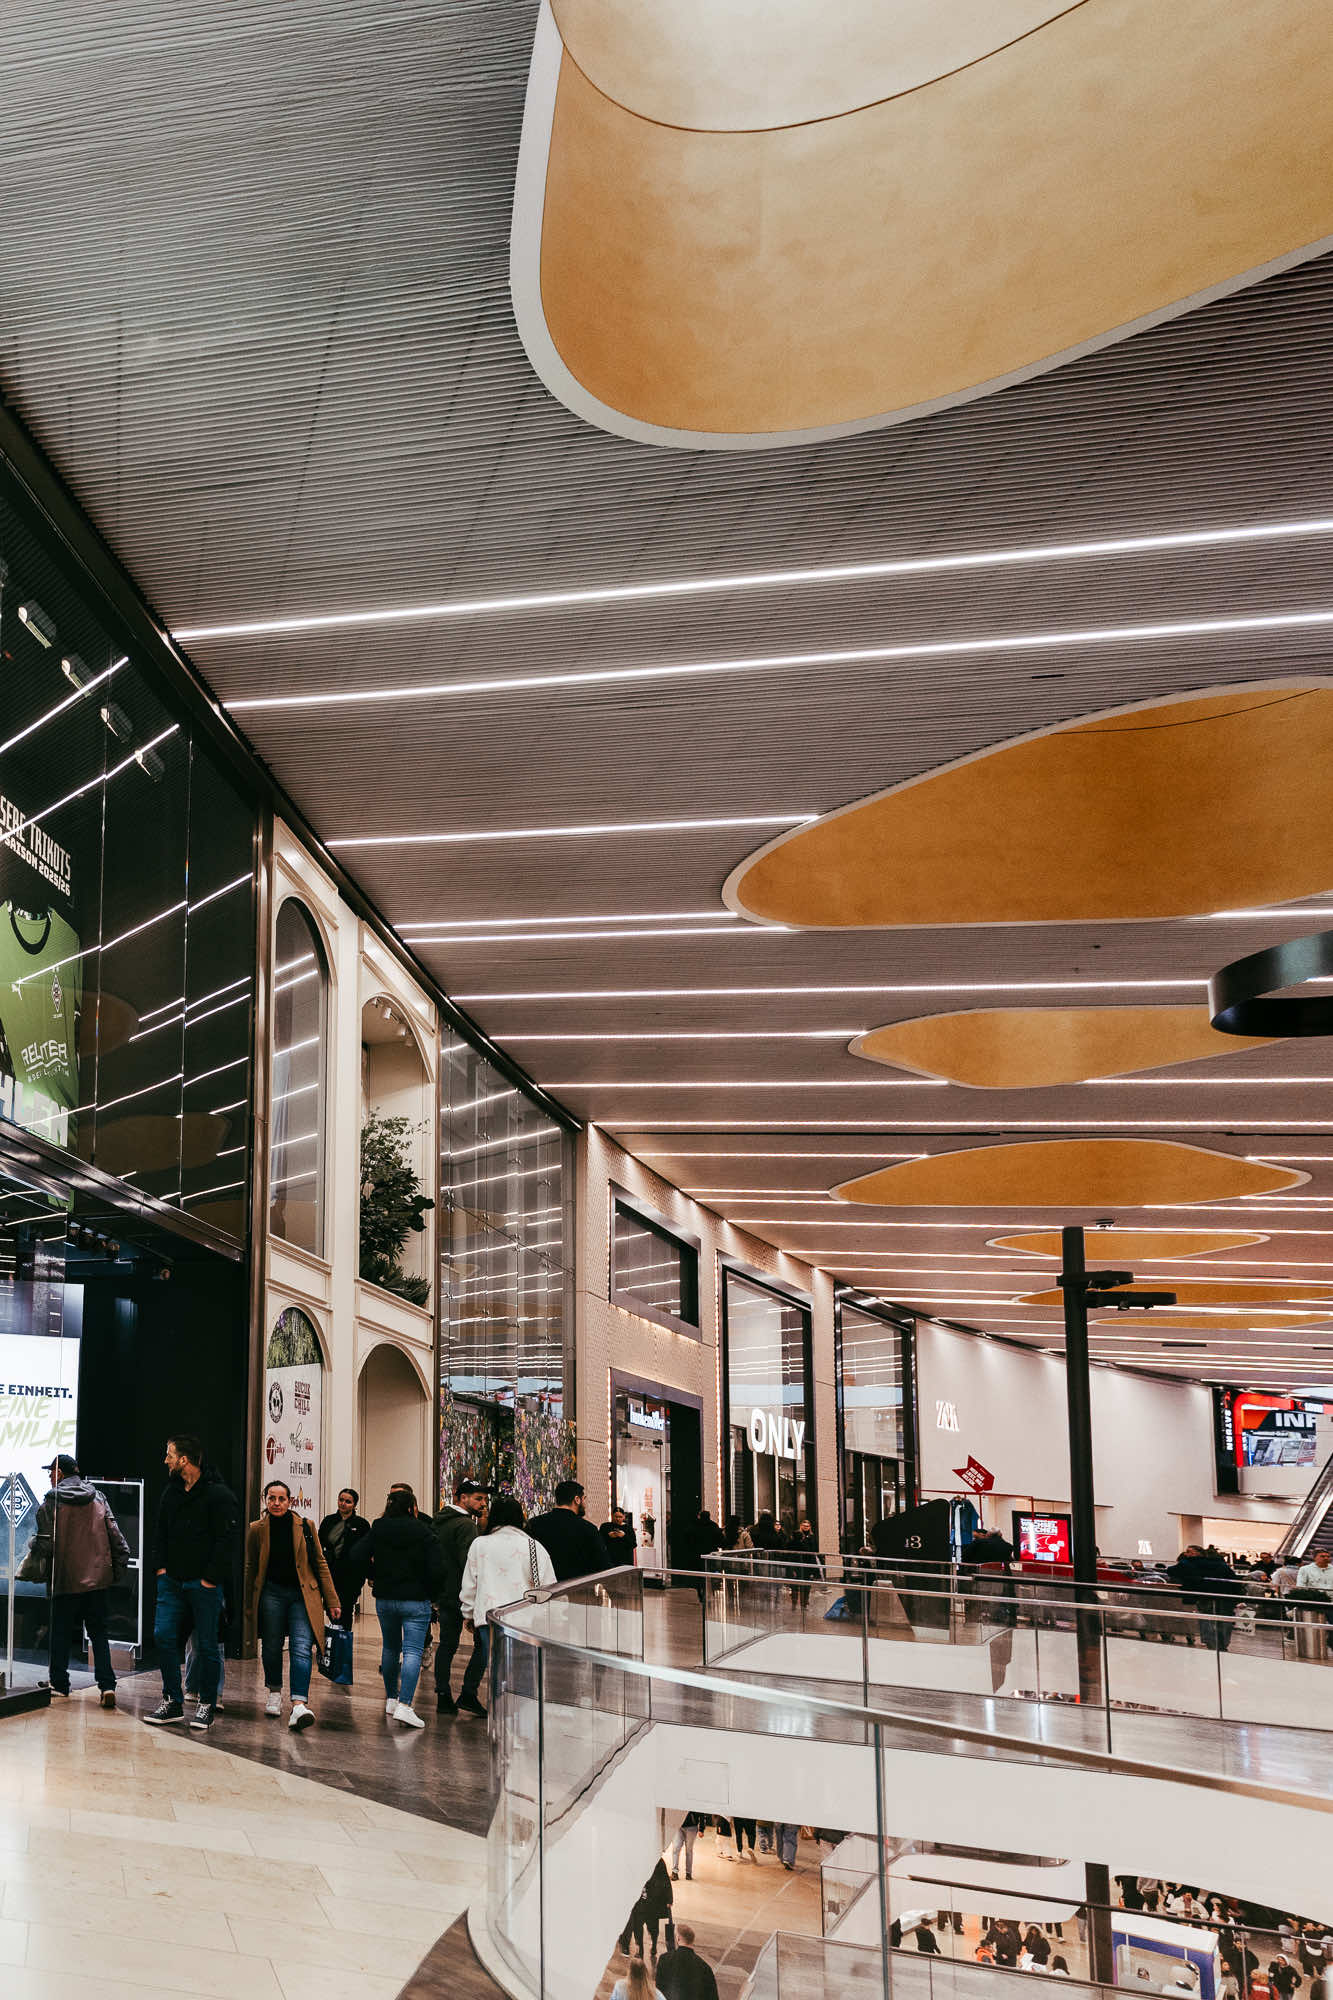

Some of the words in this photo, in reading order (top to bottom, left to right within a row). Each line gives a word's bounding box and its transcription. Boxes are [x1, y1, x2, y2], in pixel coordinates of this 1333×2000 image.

[5, 837, 38, 870] SAISON
[39, 860, 71, 896] 2025/26
[30, 822, 71, 881] TRIKOTS
[8, 1384, 73, 1399] EINHEIT.
[750, 1408, 805, 1460] ONLY
[1224, 1409, 1233, 1451] SATURN
